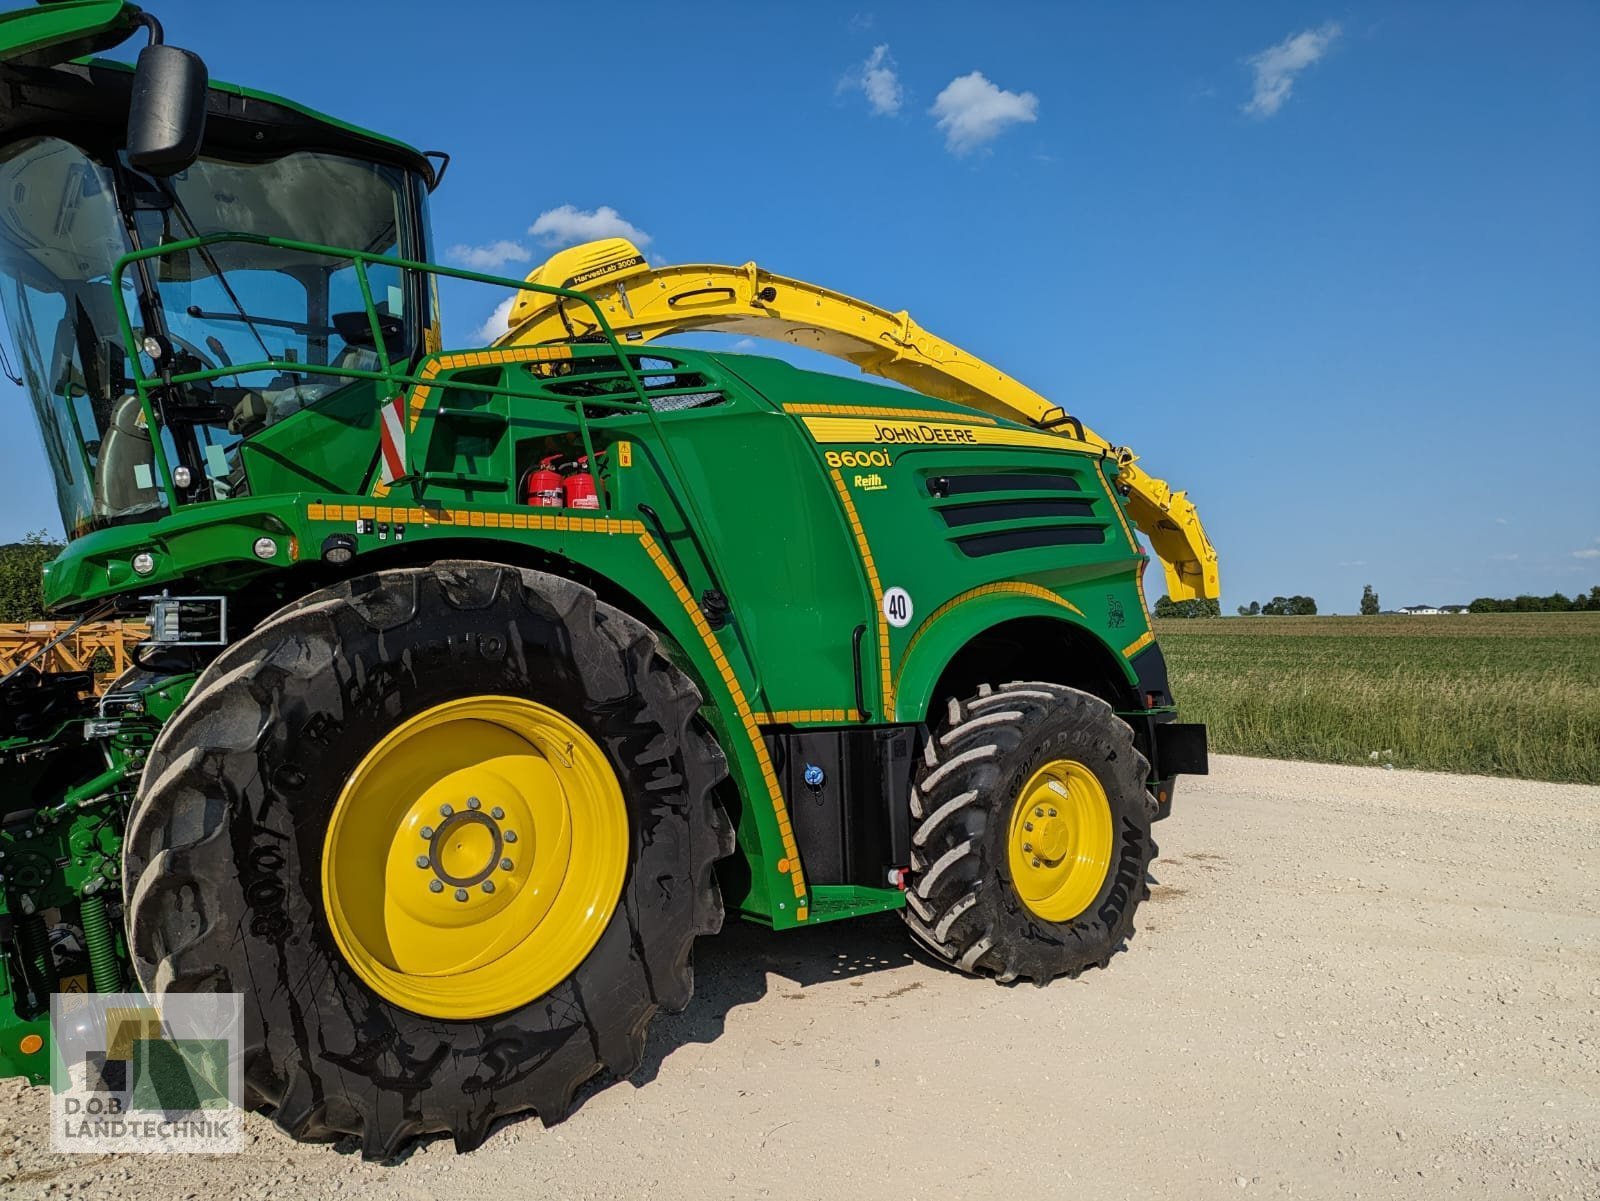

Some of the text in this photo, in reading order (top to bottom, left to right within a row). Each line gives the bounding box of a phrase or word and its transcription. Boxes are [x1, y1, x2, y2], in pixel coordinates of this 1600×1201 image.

[573, 258, 637, 285] HarvestLab 3000
[874, 424, 977, 443] JOHN DEERE
[824, 448, 893, 468] 8600i
[889, 594, 907, 620] 40
